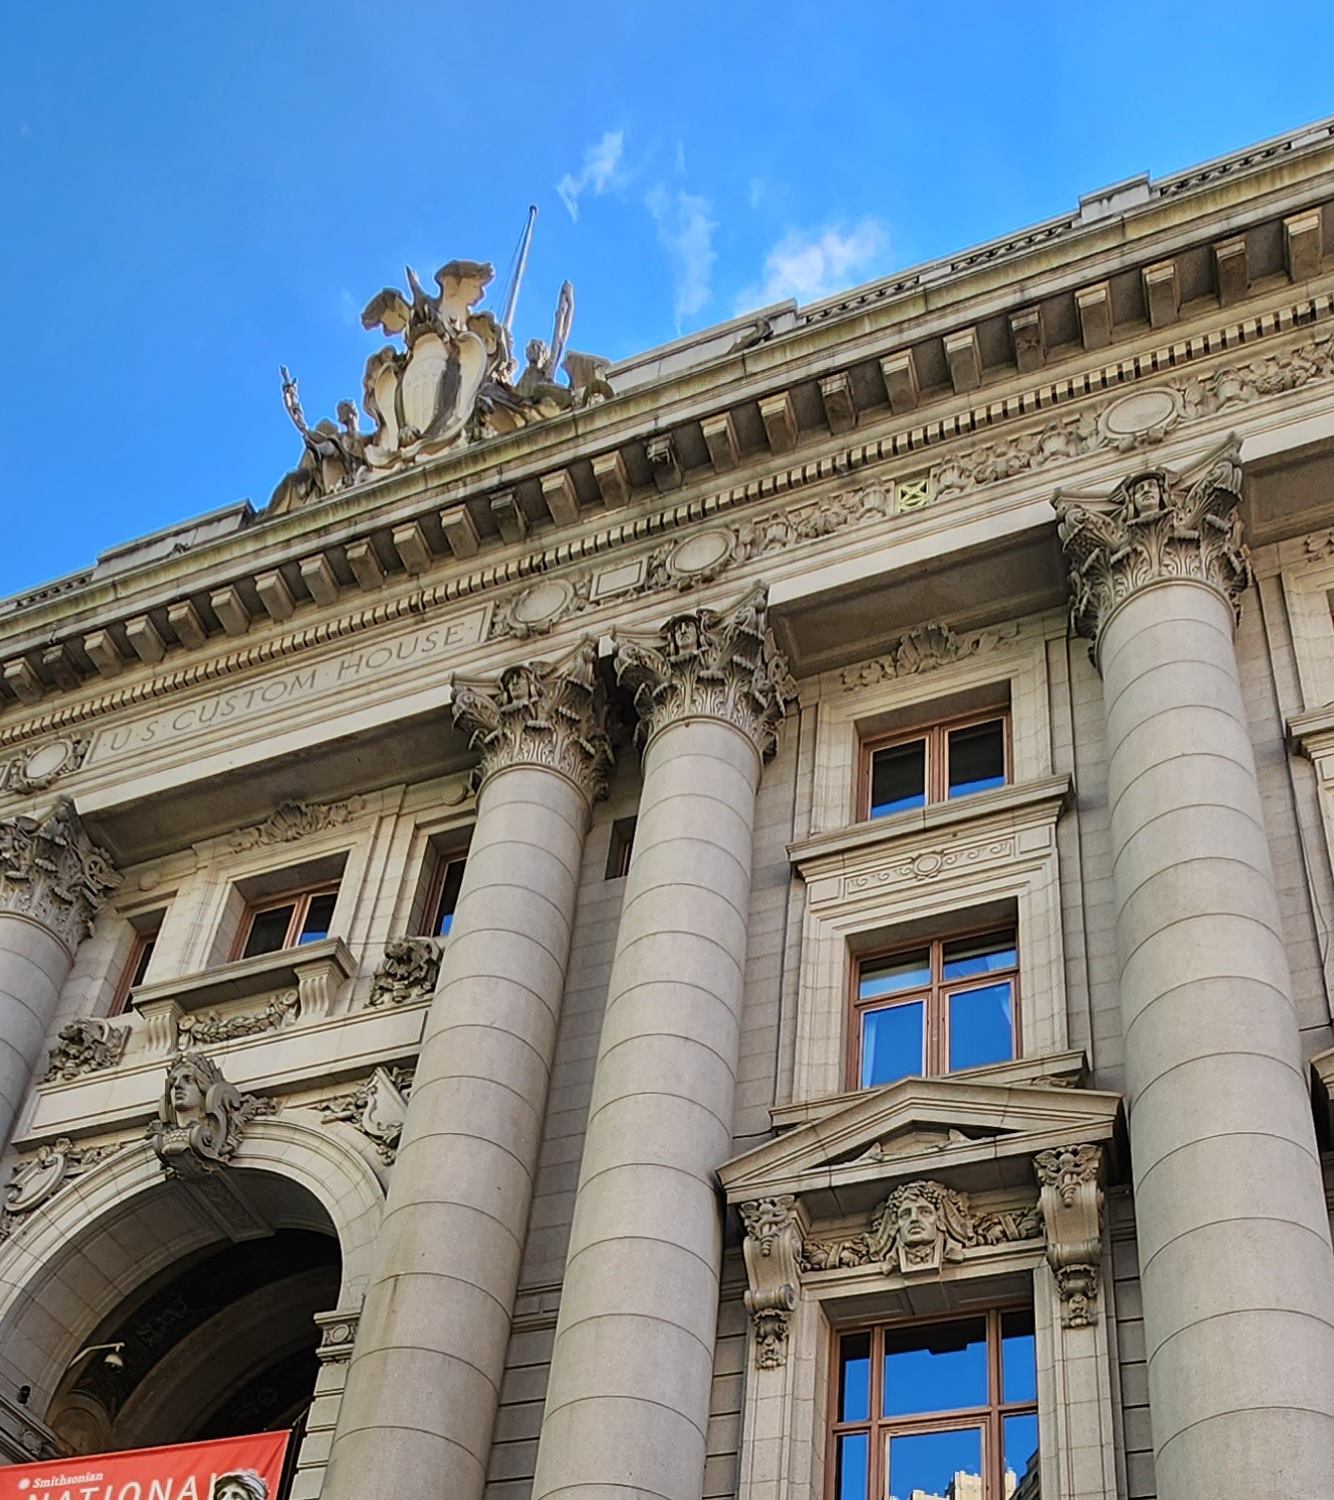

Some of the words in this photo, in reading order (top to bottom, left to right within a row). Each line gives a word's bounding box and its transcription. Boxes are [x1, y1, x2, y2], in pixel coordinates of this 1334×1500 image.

[171, 668, 318, 732] CUSTOM
[337, 624, 465, 680] HOUSE
[32, 1471, 104, 1489] Smithsonian
